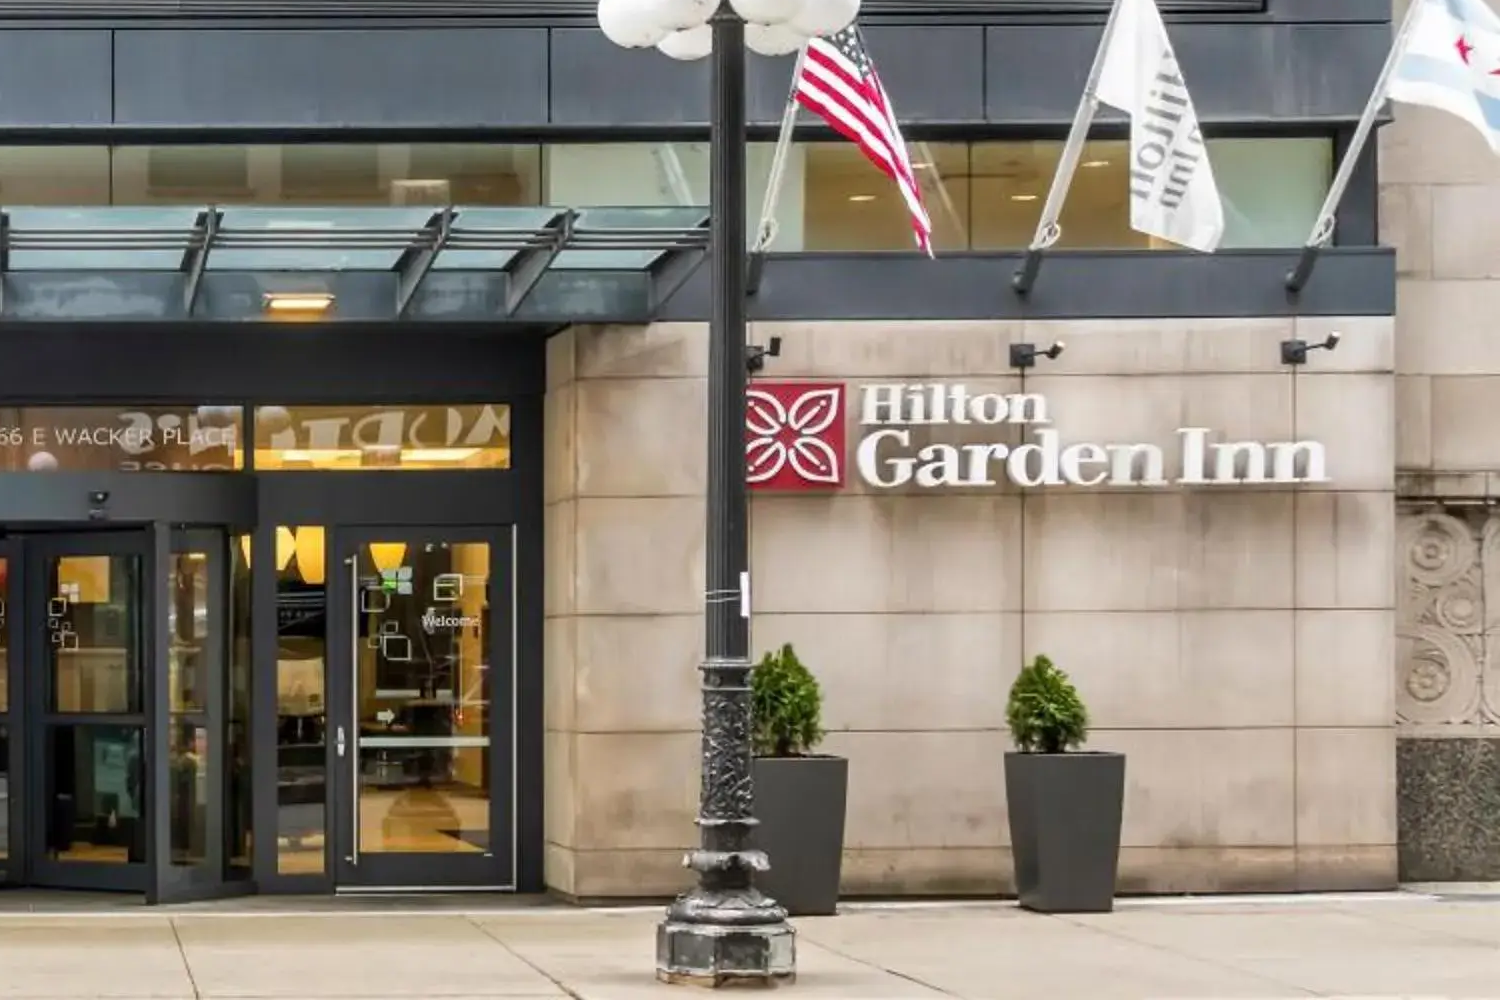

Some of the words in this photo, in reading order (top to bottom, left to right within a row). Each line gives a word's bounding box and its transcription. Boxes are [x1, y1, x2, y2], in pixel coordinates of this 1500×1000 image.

[858, 384, 1053, 426] Hilton
[32, 427, 47, 445] E
[54, 427, 152, 446] WACKER
[162, 427, 235, 445] PLACE
[855, 428, 1169, 488] Garden
[1176, 427, 1332, 485] Inn
[421, 614, 481, 628] Welcome
